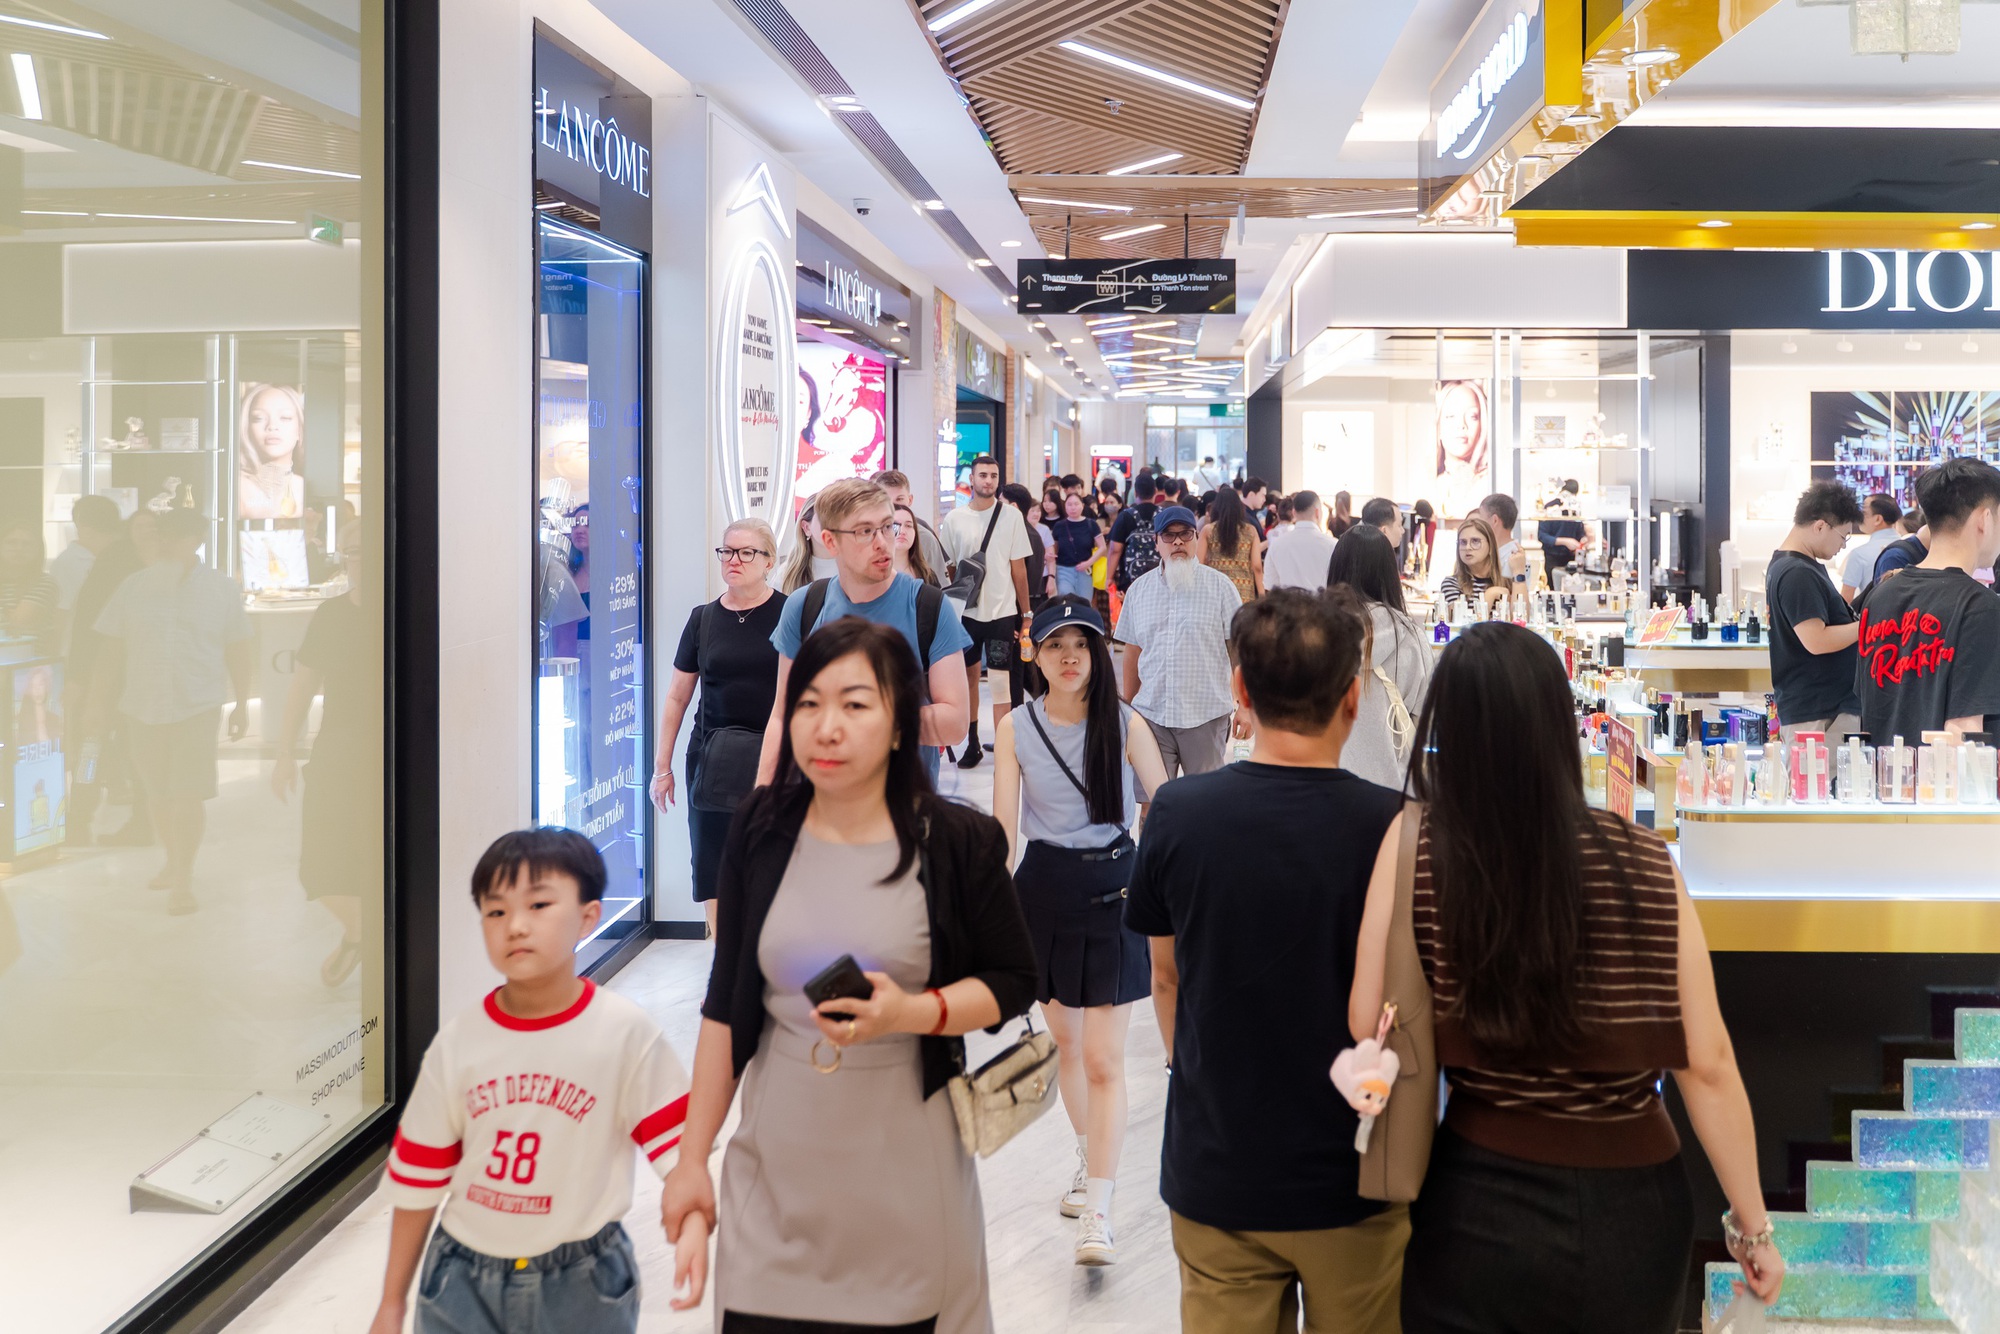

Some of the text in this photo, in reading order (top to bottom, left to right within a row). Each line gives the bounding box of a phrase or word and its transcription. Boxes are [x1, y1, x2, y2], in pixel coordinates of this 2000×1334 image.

[540, 87, 650, 198] LANCÔME
[825, 260, 873, 327] LANCÔME
[1042, 273, 1066, 282] Thang
[1189, 273, 1212, 281] Thánh
[1212, 273, 1228, 281] Tôn
[1820, 250, 2000, 312] DIO
[609, 572, 636, 595] +29%
[610, 637, 635, 660] -30%
[609, 698, 636, 725] +22%
[296, 1016, 378, 1084] MASSIMODUTTI.COM
[311, 1057, 366, 1107] SHOP ONLINE
[505, 1073, 597, 1123] DEFENDER
[485, 1129, 541, 1185] 58
